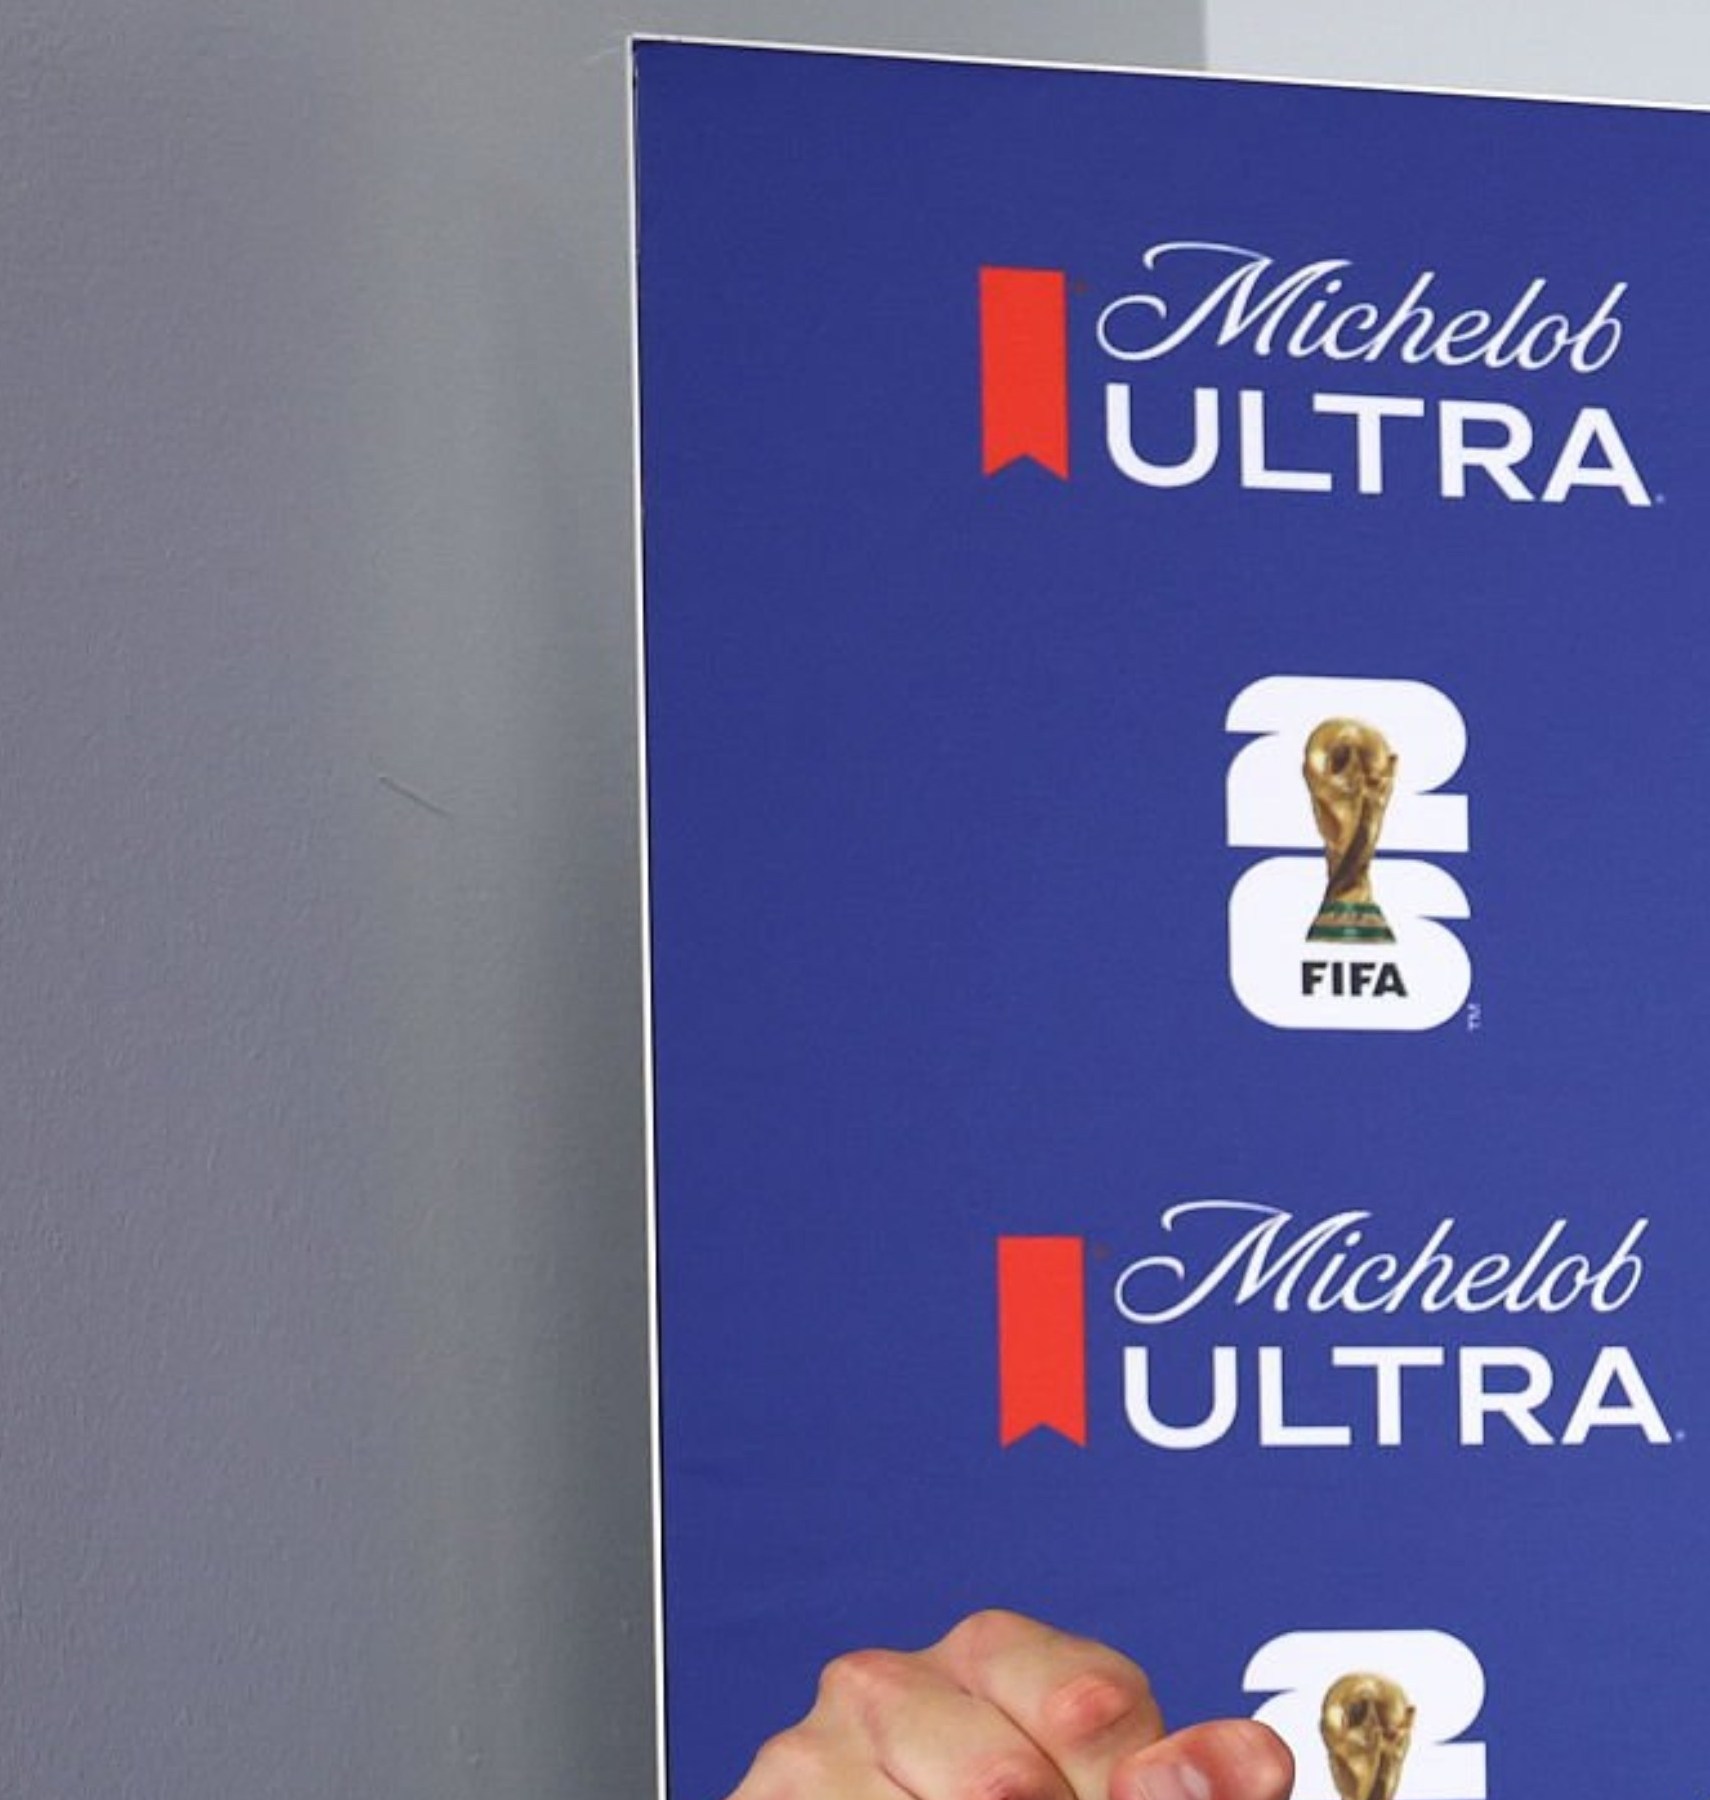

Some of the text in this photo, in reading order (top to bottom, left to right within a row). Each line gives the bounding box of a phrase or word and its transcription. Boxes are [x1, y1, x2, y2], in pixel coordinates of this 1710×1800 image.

[1097, 243, 1626, 372] Michelob
[1107, 383, 1651, 506] ULTRA
[1302, 962, 1406, 997] FIFA
[1115, 1201, 1648, 1323] Michelob
[1125, 1347, 1671, 1448] ULTRA
